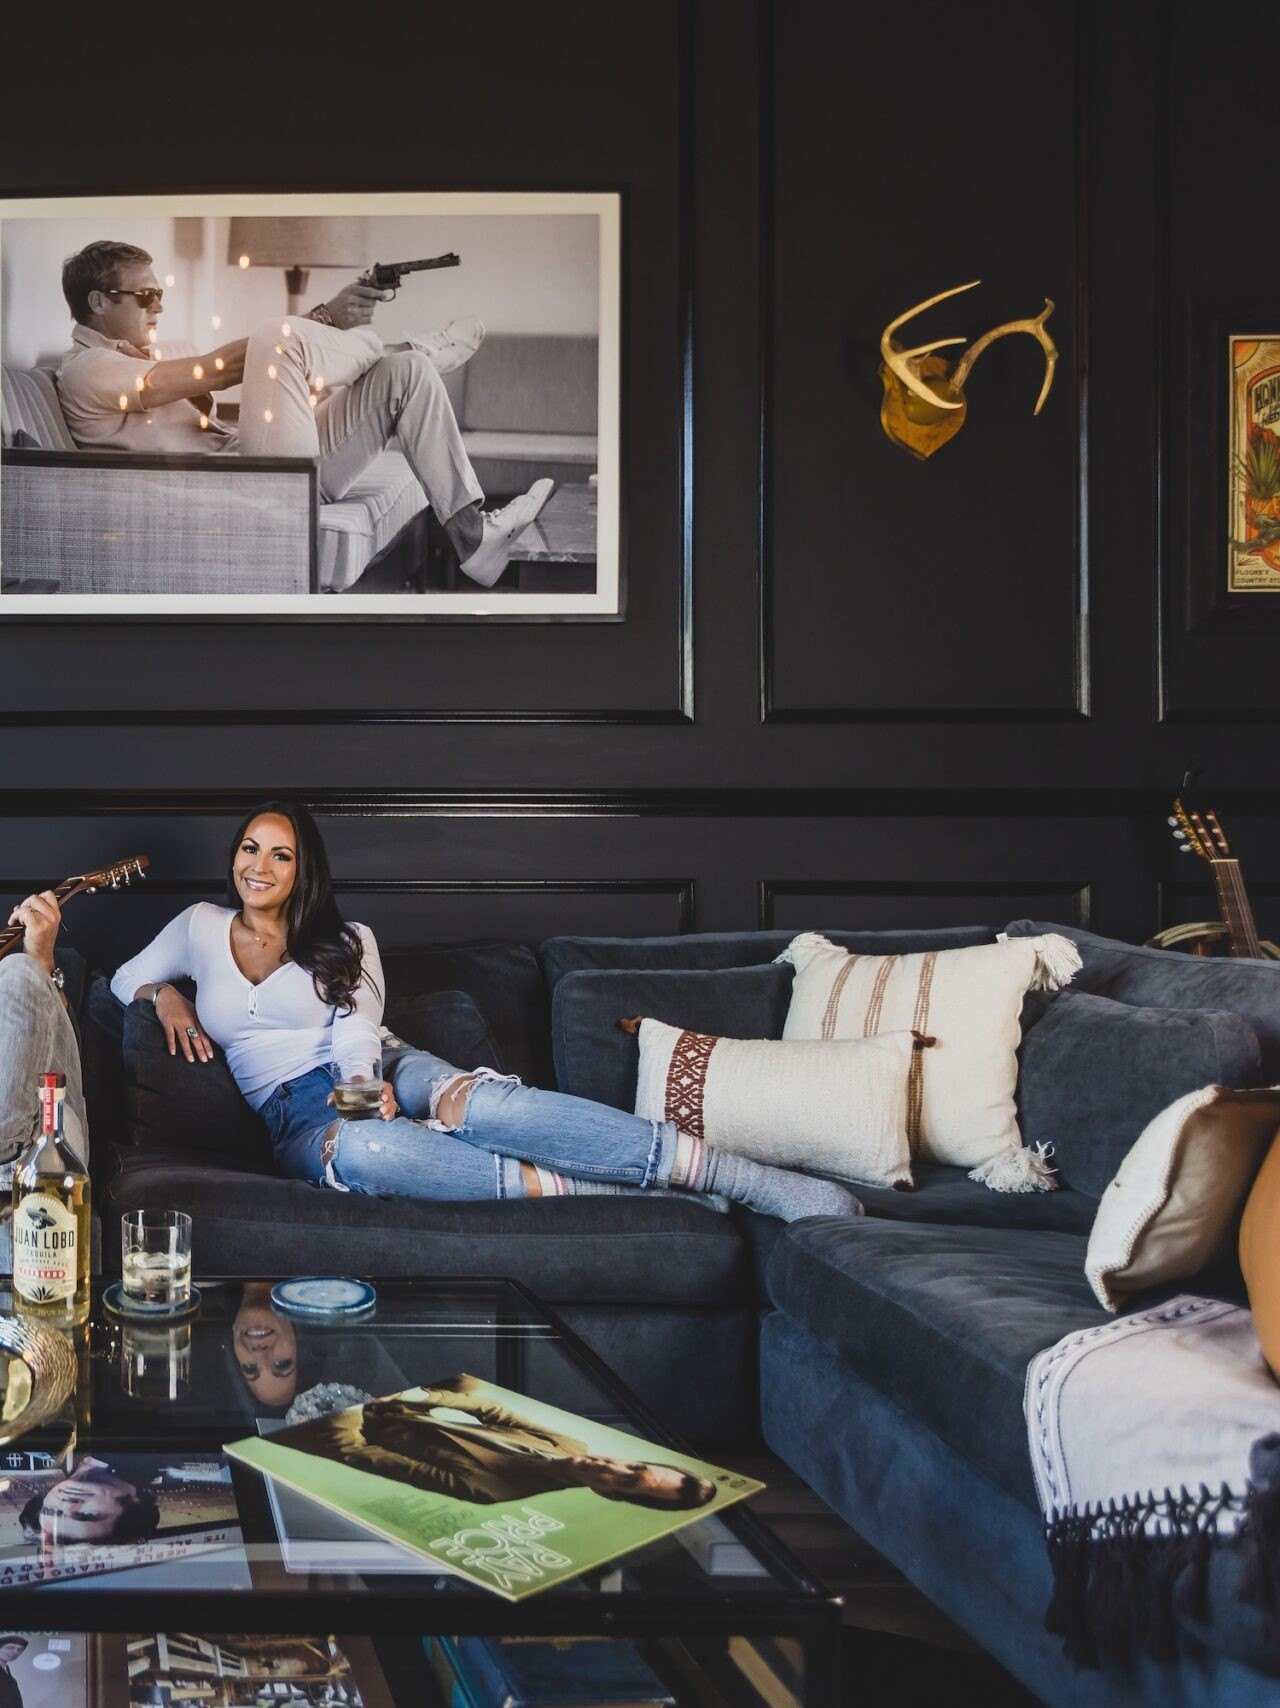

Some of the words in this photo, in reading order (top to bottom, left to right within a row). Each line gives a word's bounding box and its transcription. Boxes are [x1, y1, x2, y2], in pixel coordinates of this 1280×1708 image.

[15, 1226, 38, 1249] JUAN
[44, 1230, 75, 1250] LOBO
[26, 1249, 57, 1259] TEQUILA
[429, 1506, 566, 1567] PRICE
[0, 1562, 106, 1585] HAGGARD
[475, 1539, 572, 1590] RAY
